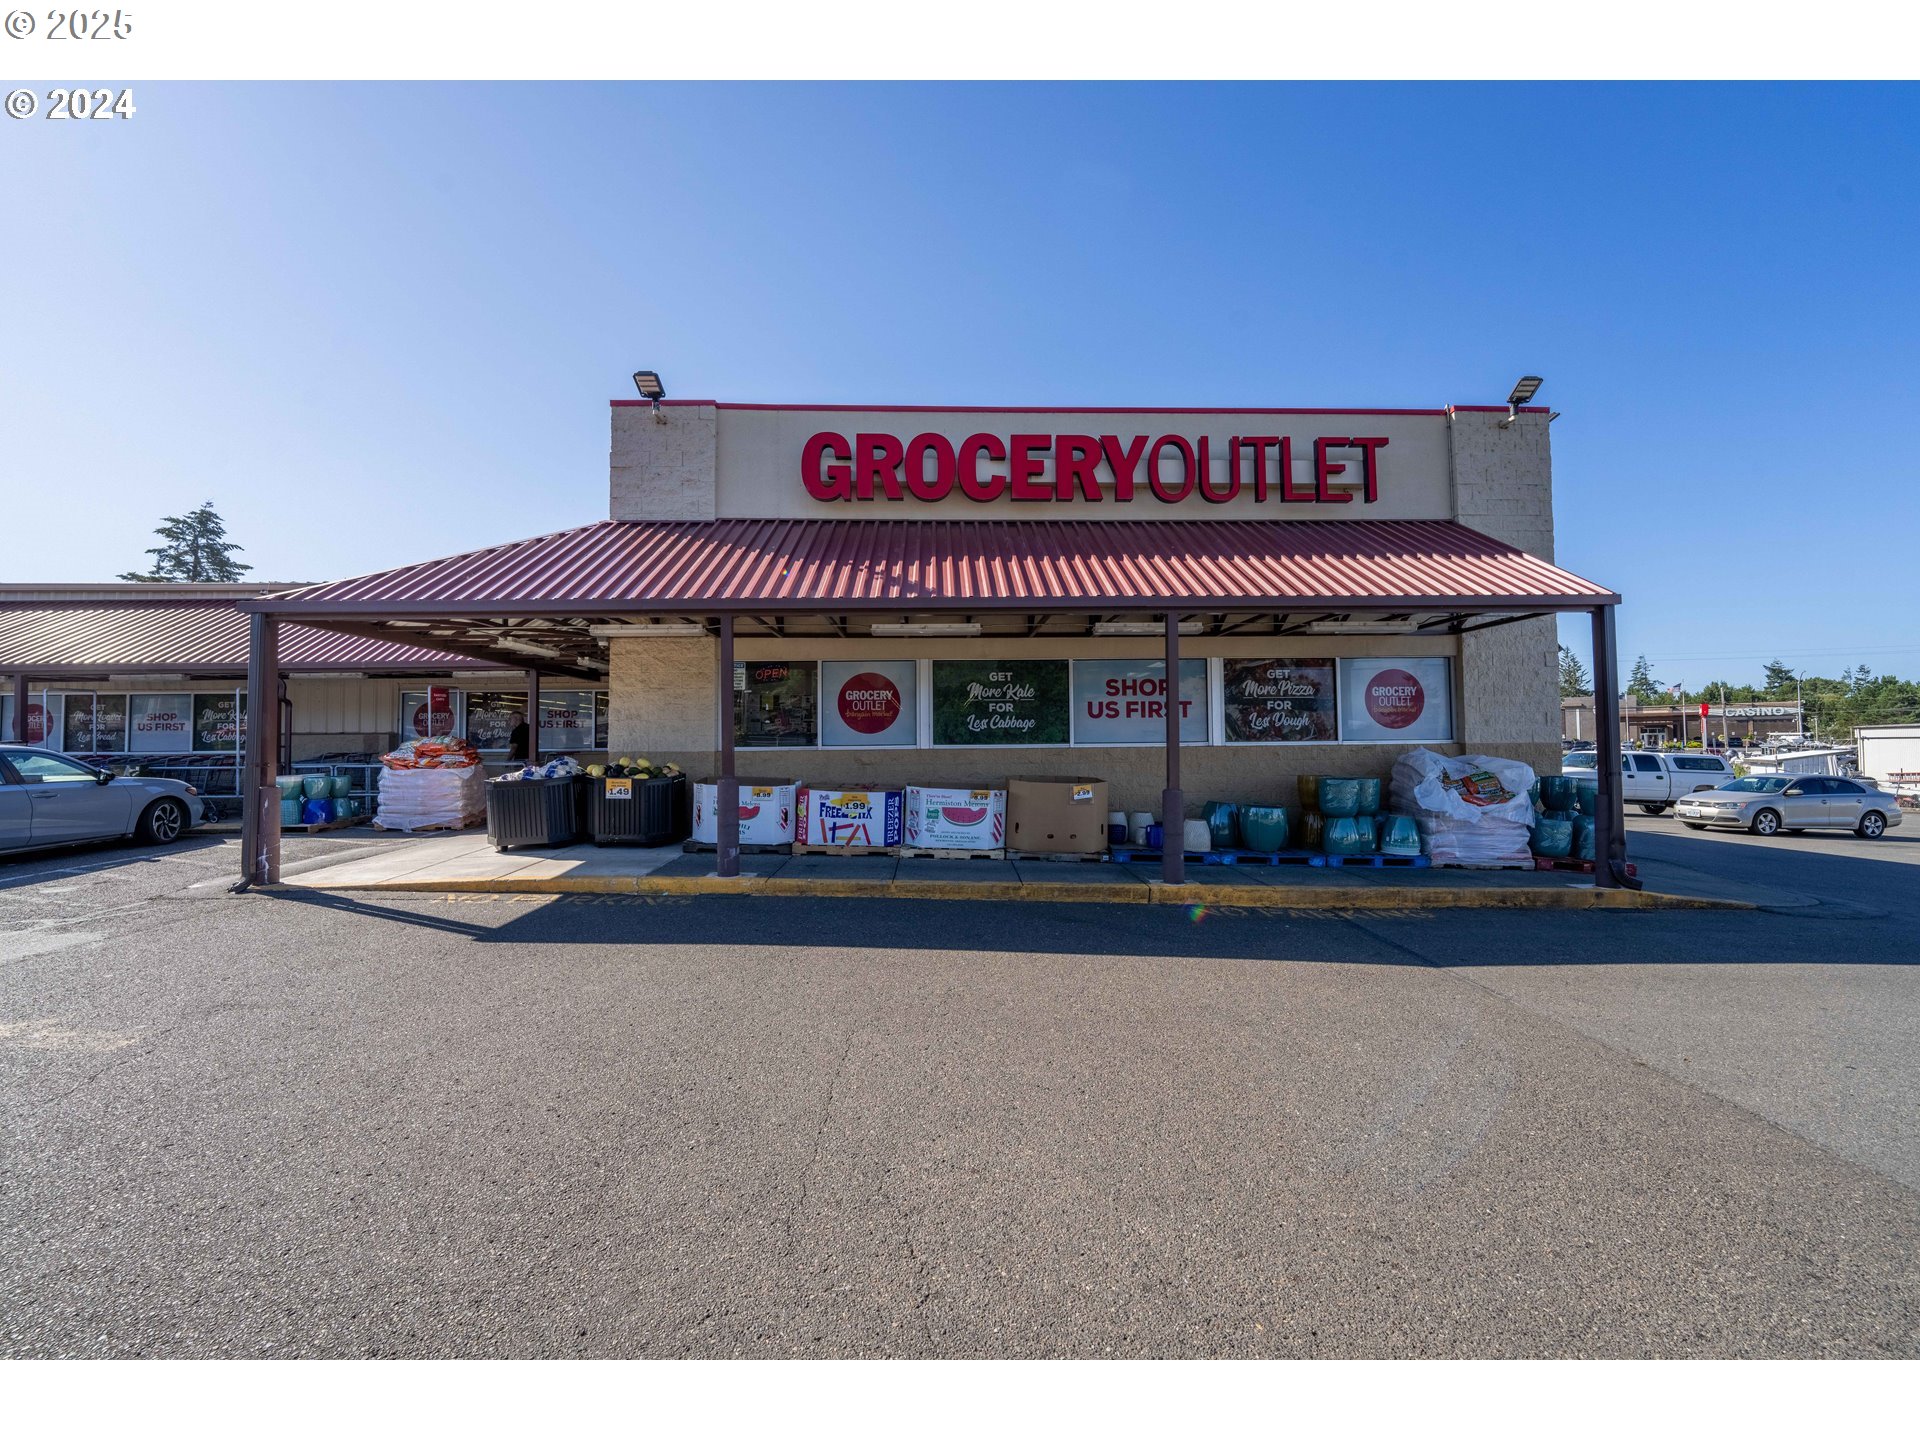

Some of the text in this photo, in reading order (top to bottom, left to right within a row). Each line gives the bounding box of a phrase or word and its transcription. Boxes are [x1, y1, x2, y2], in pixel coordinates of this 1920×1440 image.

[756, 667, 788, 679] OPEN
[989, 672, 1013, 681] GET
[1267, 669, 1290, 679] GET
[967, 682, 1035, 700] More Kale
[1243, 680, 1315, 698] More Pizza
[1372, 686, 1417, 696] GROCERY
[845, 690, 893, 701] GROCERY
[218, 701, 235, 709] GET
[852, 700, 887, 711] OUTLET
[1267, 700, 1292, 710] FOR
[1379, 696, 1411, 706] OUTLET
[989, 703, 1014, 712] FOR
[1087, 701, 1120, 719] US
[1726, 706, 1785, 717] CASINO
[146, 712, 177, 721] SHOP
[202, 708, 226, 721] More
[418, 712, 450, 720] GRCERY
[547, 710, 578, 719] SHOP
[217, 722, 235, 730] FOR
[539, 720, 554, 728] US
[967, 714, 1036, 732] Less Cabbage
[1249, 712, 1310, 730] Less Dough
[137, 722, 185, 732] US FIRST
